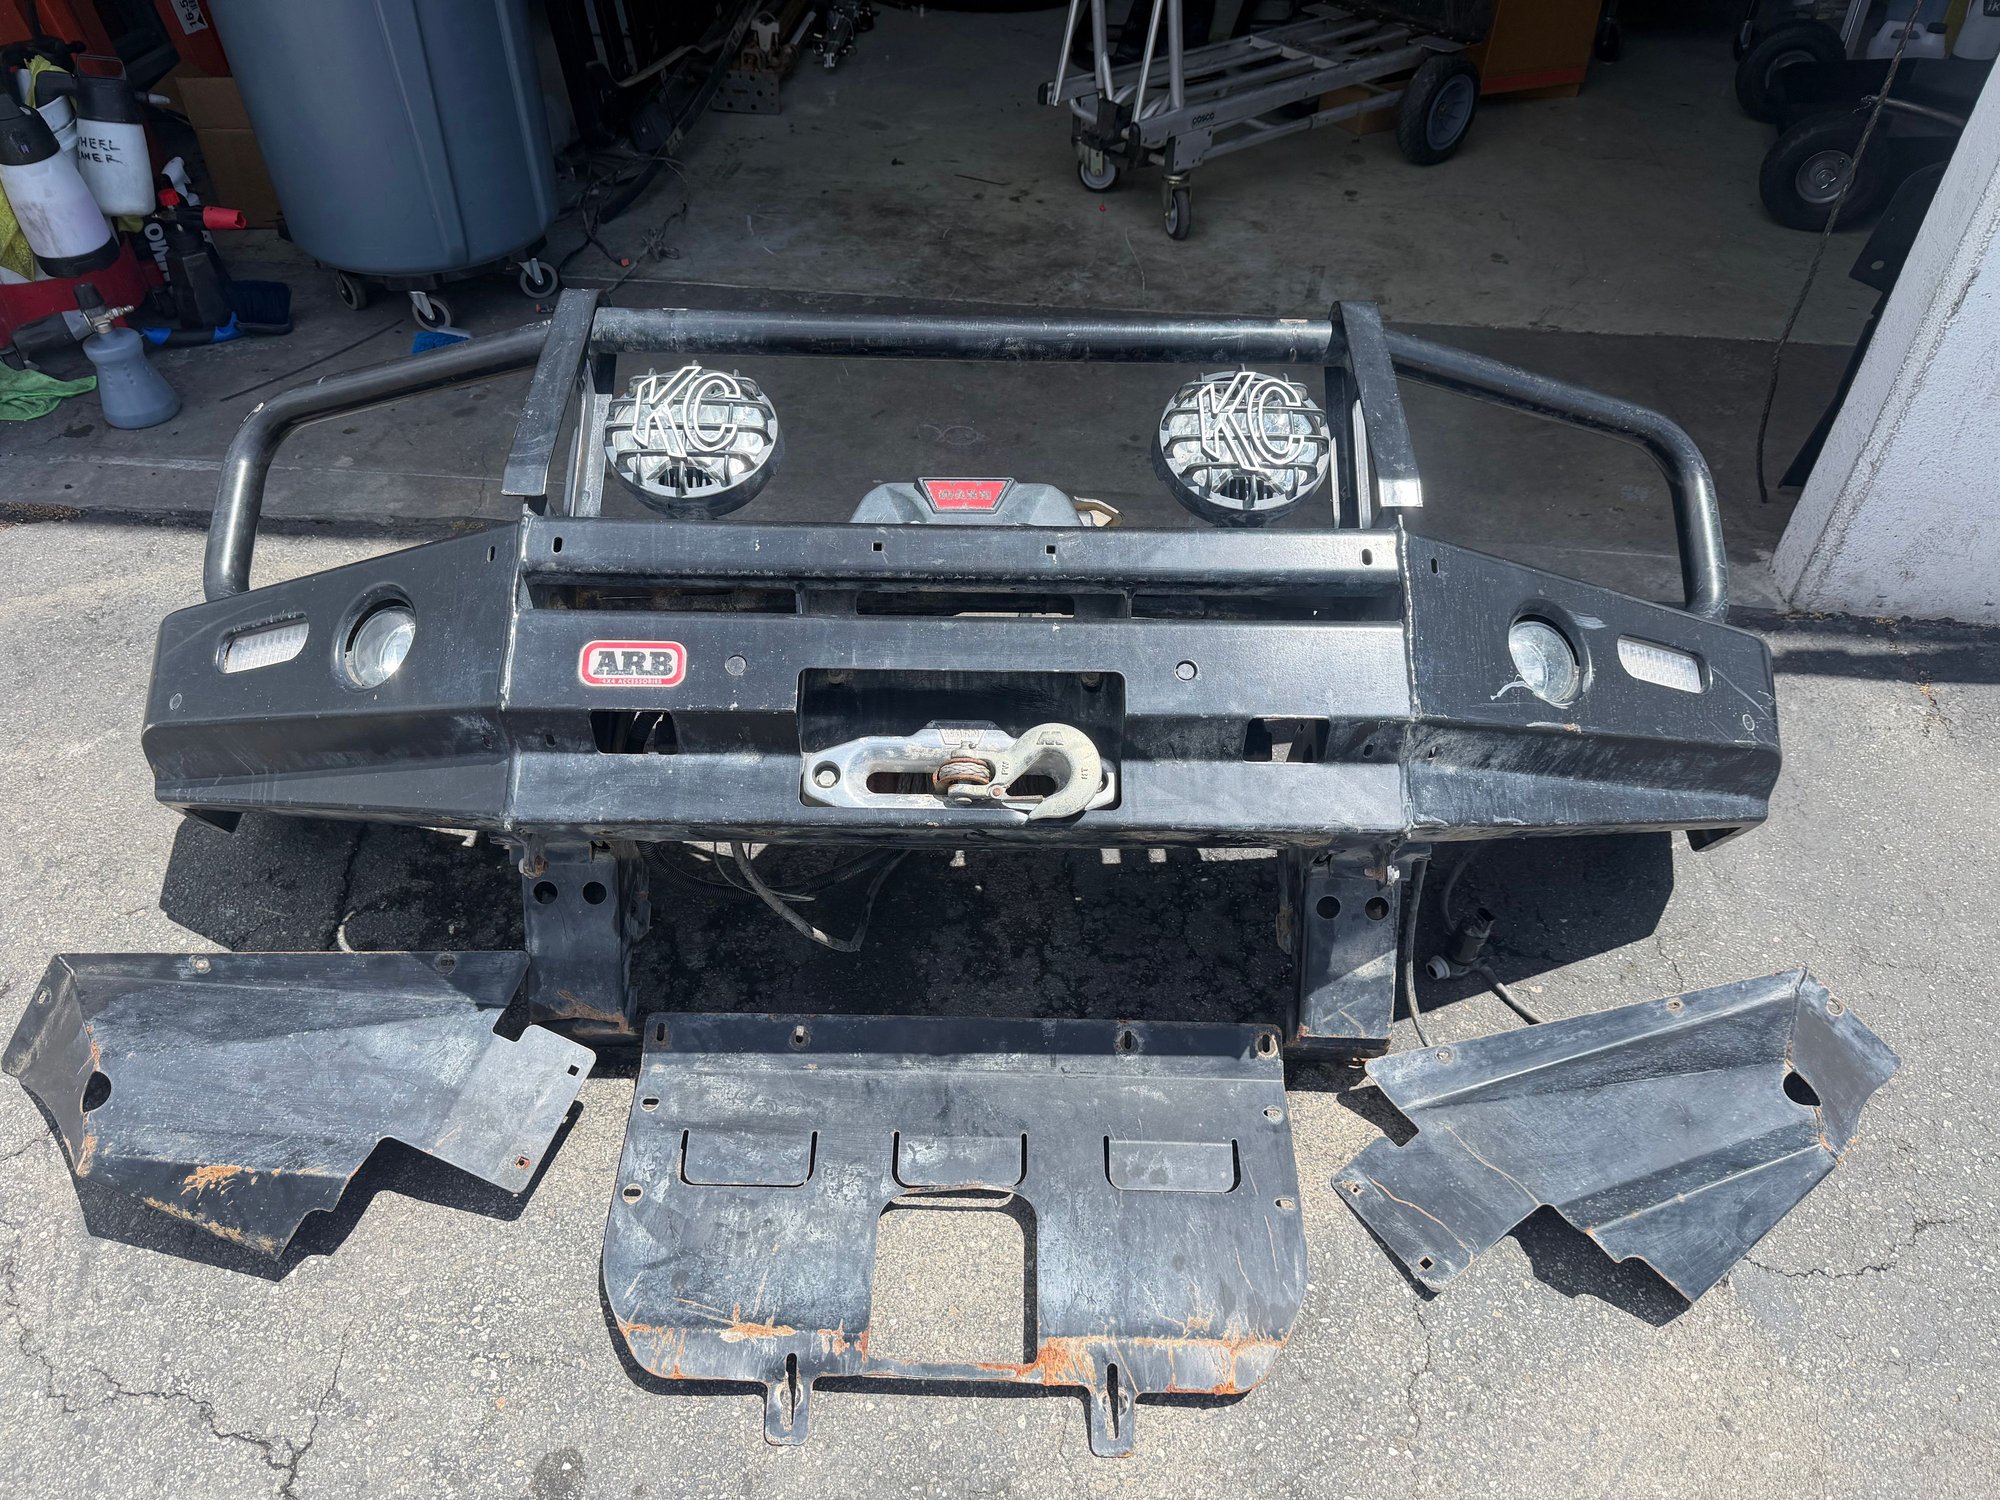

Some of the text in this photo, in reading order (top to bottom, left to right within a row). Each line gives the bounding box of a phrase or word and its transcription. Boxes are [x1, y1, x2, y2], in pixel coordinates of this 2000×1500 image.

[78, 151, 124, 165] ANER
[632, 366, 741, 458] KC
[1198, 372, 1305, 470] KC
[593, 651, 674, 676] ARB
